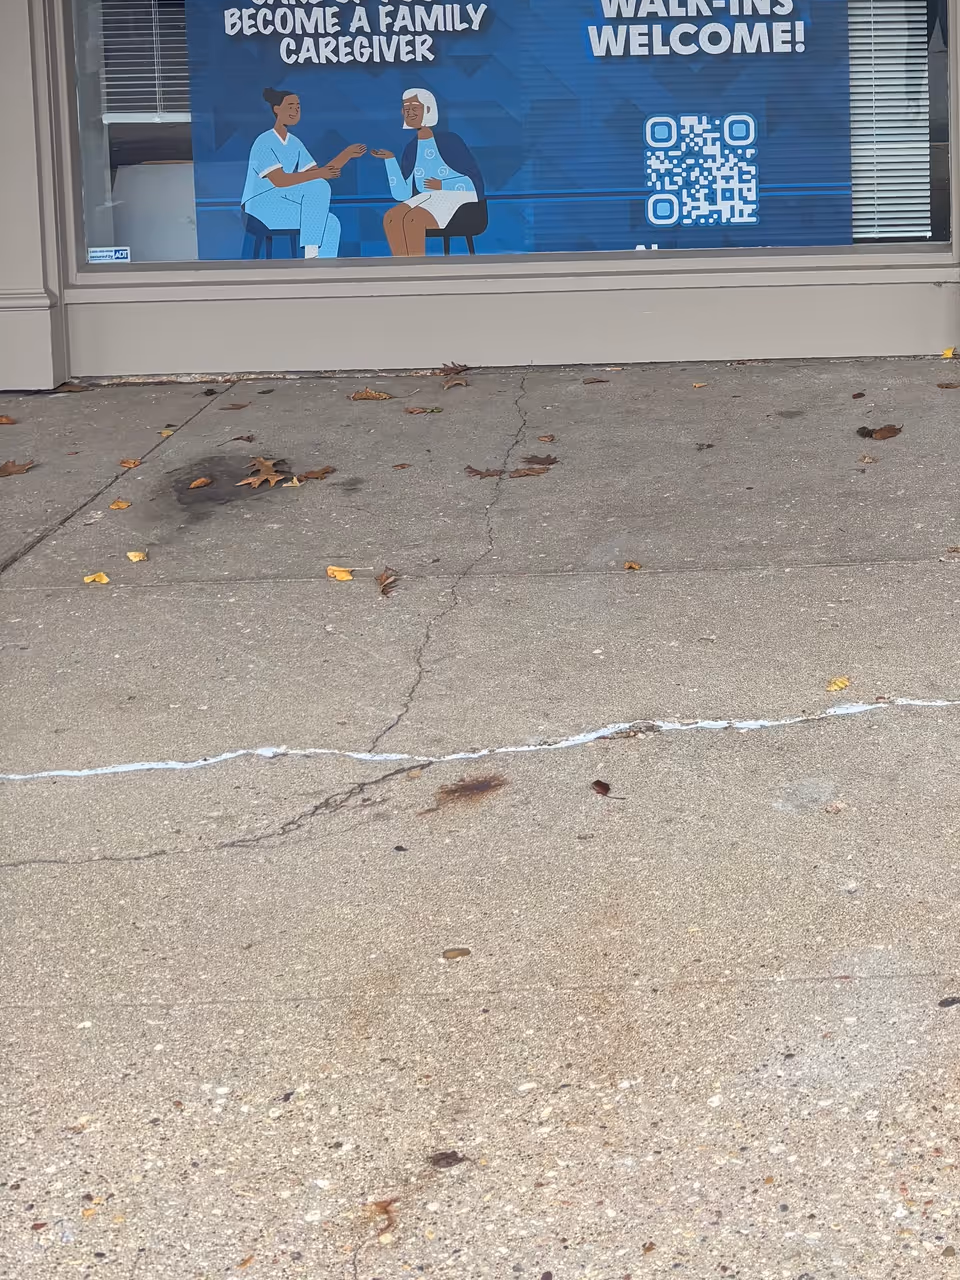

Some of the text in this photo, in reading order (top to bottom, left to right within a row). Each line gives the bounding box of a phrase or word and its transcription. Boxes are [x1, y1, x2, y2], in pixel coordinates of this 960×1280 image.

[224, 3, 487, 36] BECOME A FAMILY
[279, 34, 435, 65] CAREGIVER
[587, 20, 805, 57] WELCOME!
